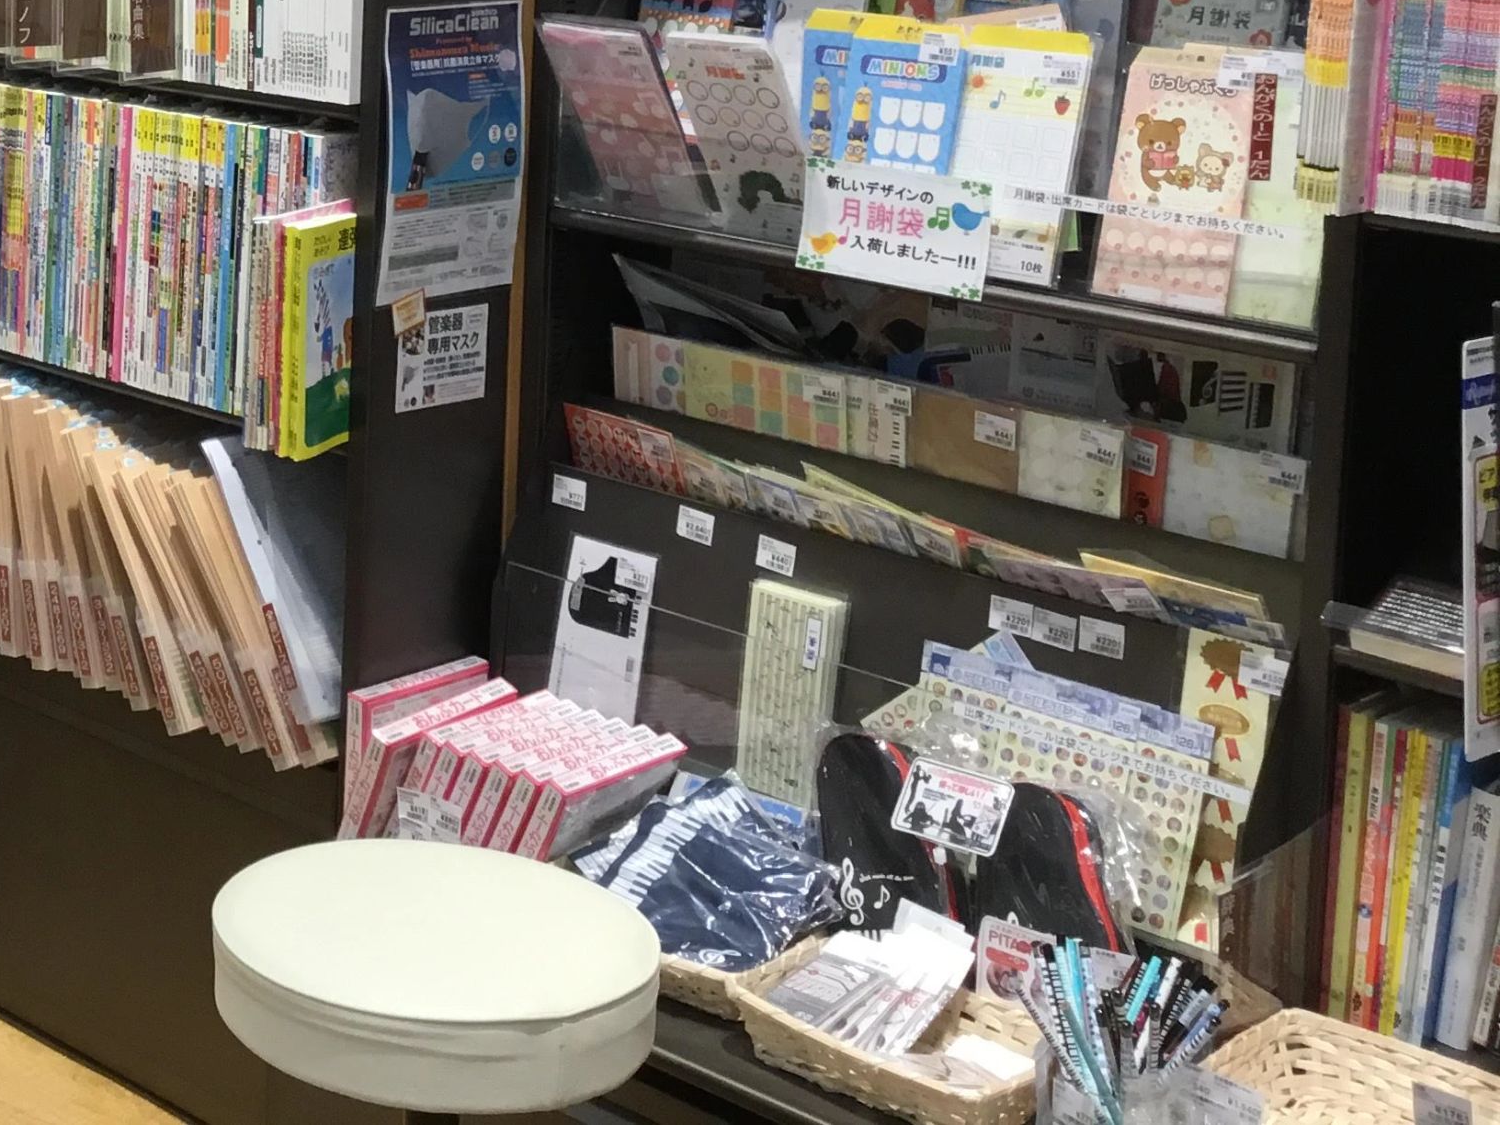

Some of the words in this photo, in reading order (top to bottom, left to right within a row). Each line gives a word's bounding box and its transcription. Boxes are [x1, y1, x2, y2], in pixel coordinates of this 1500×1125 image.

[409, 13, 499, 36] SilicaClean
[1188, 6, 1252, 31] 月謝袋
[826, 174, 934, 204] 新しいデザインの
[838, 198, 925, 238] 月謝袋
[1013, 187, 1285, 240] 月謝袋・出席カードは袋ごとレジまでお持ちください。
[1019, 259, 1044, 274] 10枚
[428, 312, 463, 335] 管楽器
[427, 330, 479, 355] 専用マスク
[412, 691, 484, 727] おんぷカード
[587, 745, 654, 779] おんぷカード
[964, 708, 1232, 799] 出席カード・シールは袋ごとレジまでお持ちください。
